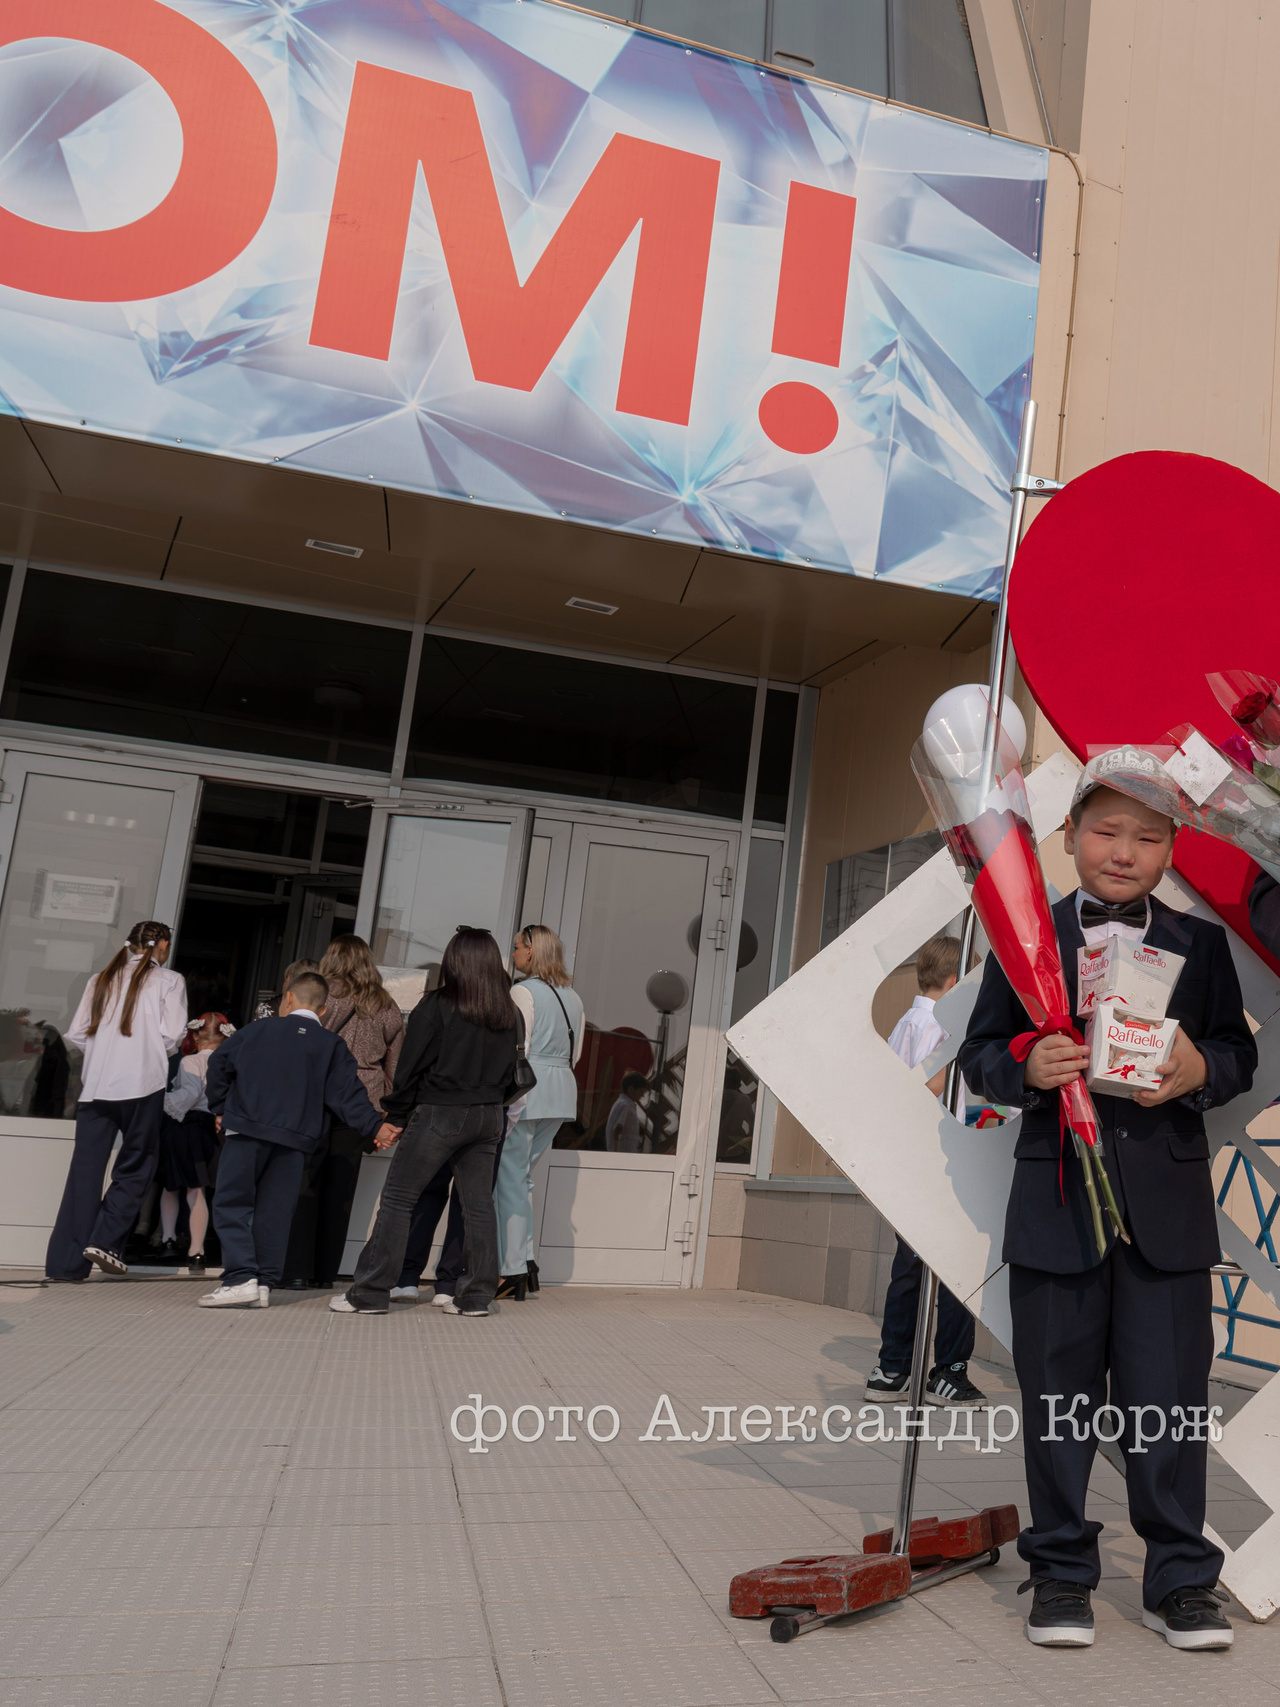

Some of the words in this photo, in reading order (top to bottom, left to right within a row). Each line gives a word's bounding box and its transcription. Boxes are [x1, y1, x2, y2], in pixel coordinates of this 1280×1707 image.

[1080, 957, 1109, 976] Raffaello
[1132, 950, 1167, 968] Raffaello
[1107, 1025, 1164, 1049] Raffaello
